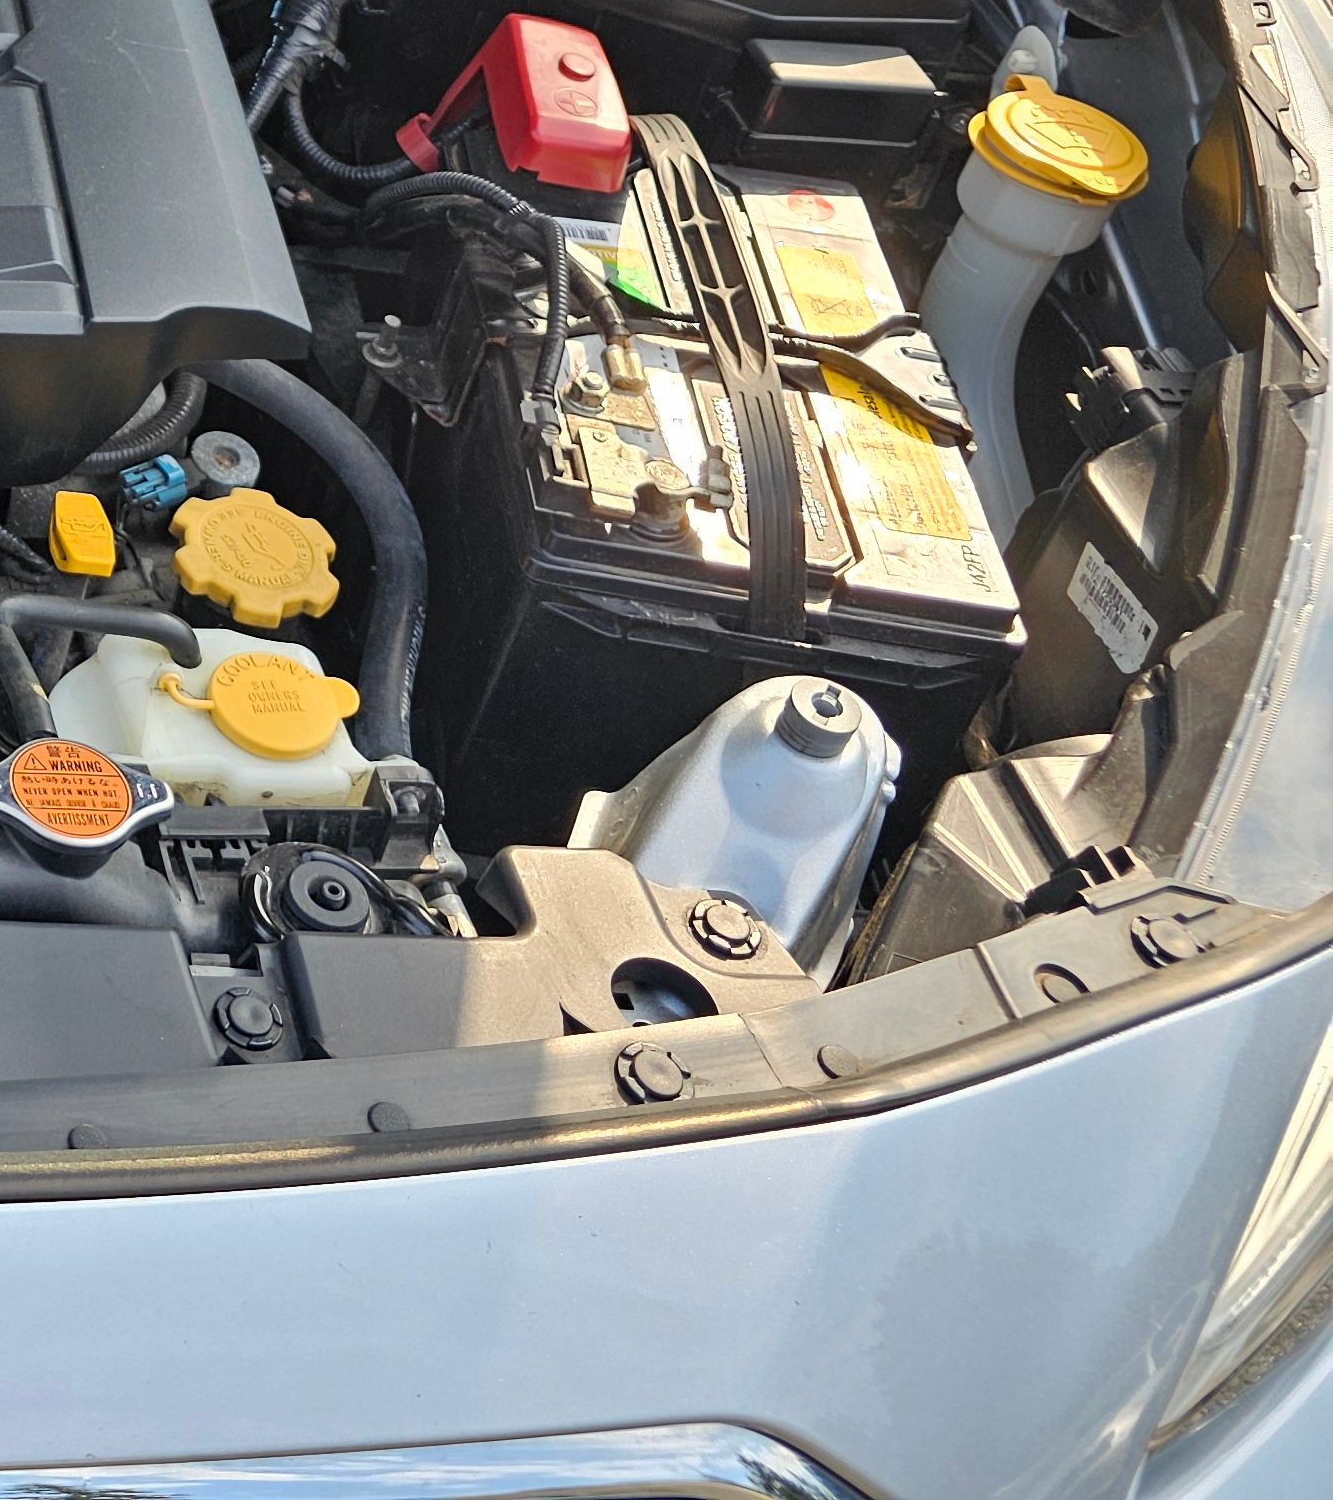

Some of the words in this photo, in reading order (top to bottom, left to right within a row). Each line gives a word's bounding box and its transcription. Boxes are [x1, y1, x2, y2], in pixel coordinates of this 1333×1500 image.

[216, 653, 316, 688] COOLANT
[250, 679, 278, 690] SEE
[248, 689, 301, 702] OWNERS
[250, 701, 306, 715] MANUAL
[48, 759, 103, 773] WARNING
[22, 787, 48, 796] NEVER
[51, 787, 73, 796] OPEN
[76, 788, 99, 797] WHEN
